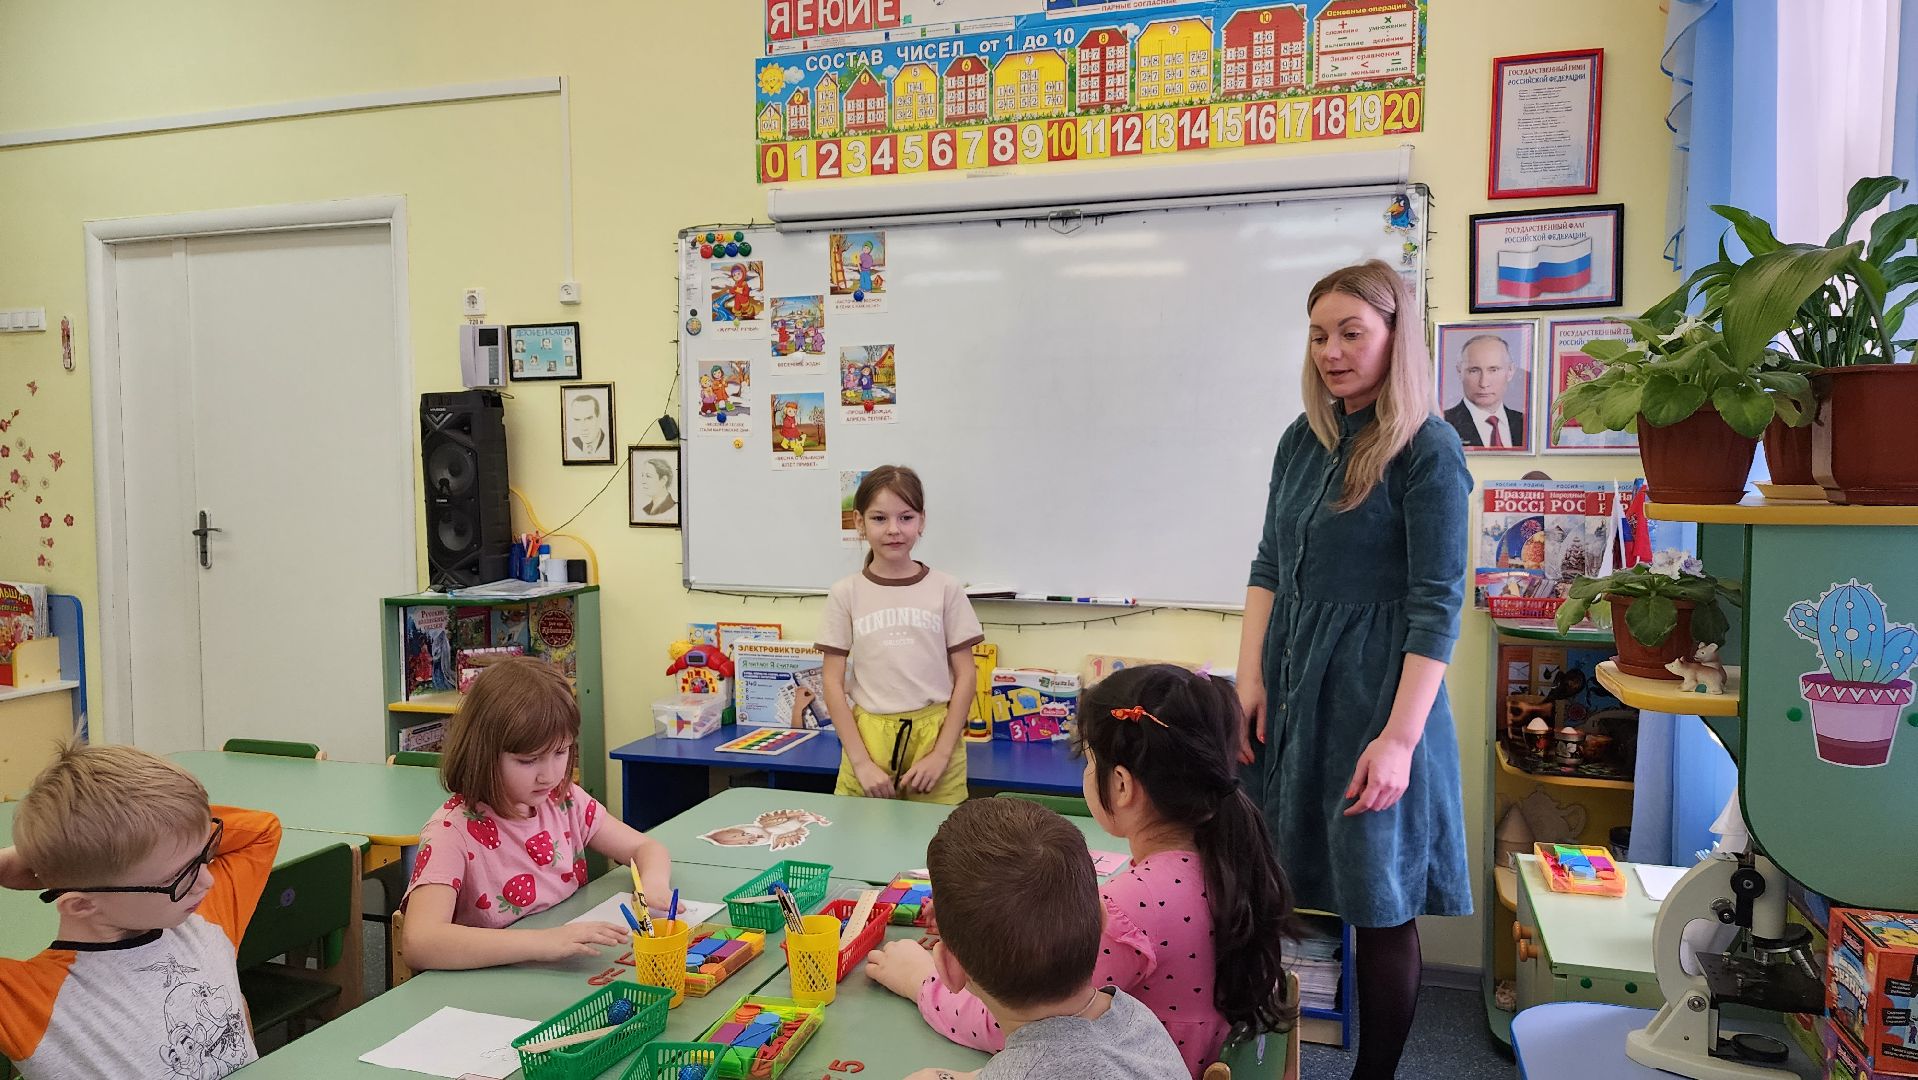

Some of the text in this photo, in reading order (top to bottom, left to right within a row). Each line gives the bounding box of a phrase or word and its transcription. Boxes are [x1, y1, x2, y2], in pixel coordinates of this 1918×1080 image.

[806, 27, 1075, 71] СОСТАВ ЧИСЕЛ от 1 до 10
[1508, 64, 1568, 76] ГОСУДАРСТВЕННЫЙ
[1508, 73, 1586, 86] РОССИЙСКОЙ ФЕДЕРАЦИИ
[765, 93, 1421, 177] 0 1 2 3 4 5 6 7 8 9 10 11 12 13 14 15 16 17 18 19 20
[1505, 222, 1568, 234] ГОСУДАРСТВЕННЫЙ
[1504, 232, 1588, 244] РОССИЙСКОЙ ФЕДЕРАЦИИ
[1560, 327, 1621, 337] ГОСУДАРСТВЕННЫЙ
[854, 607, 941, 636] KINDNESS
[1013, 725, 1023, 739] 3
